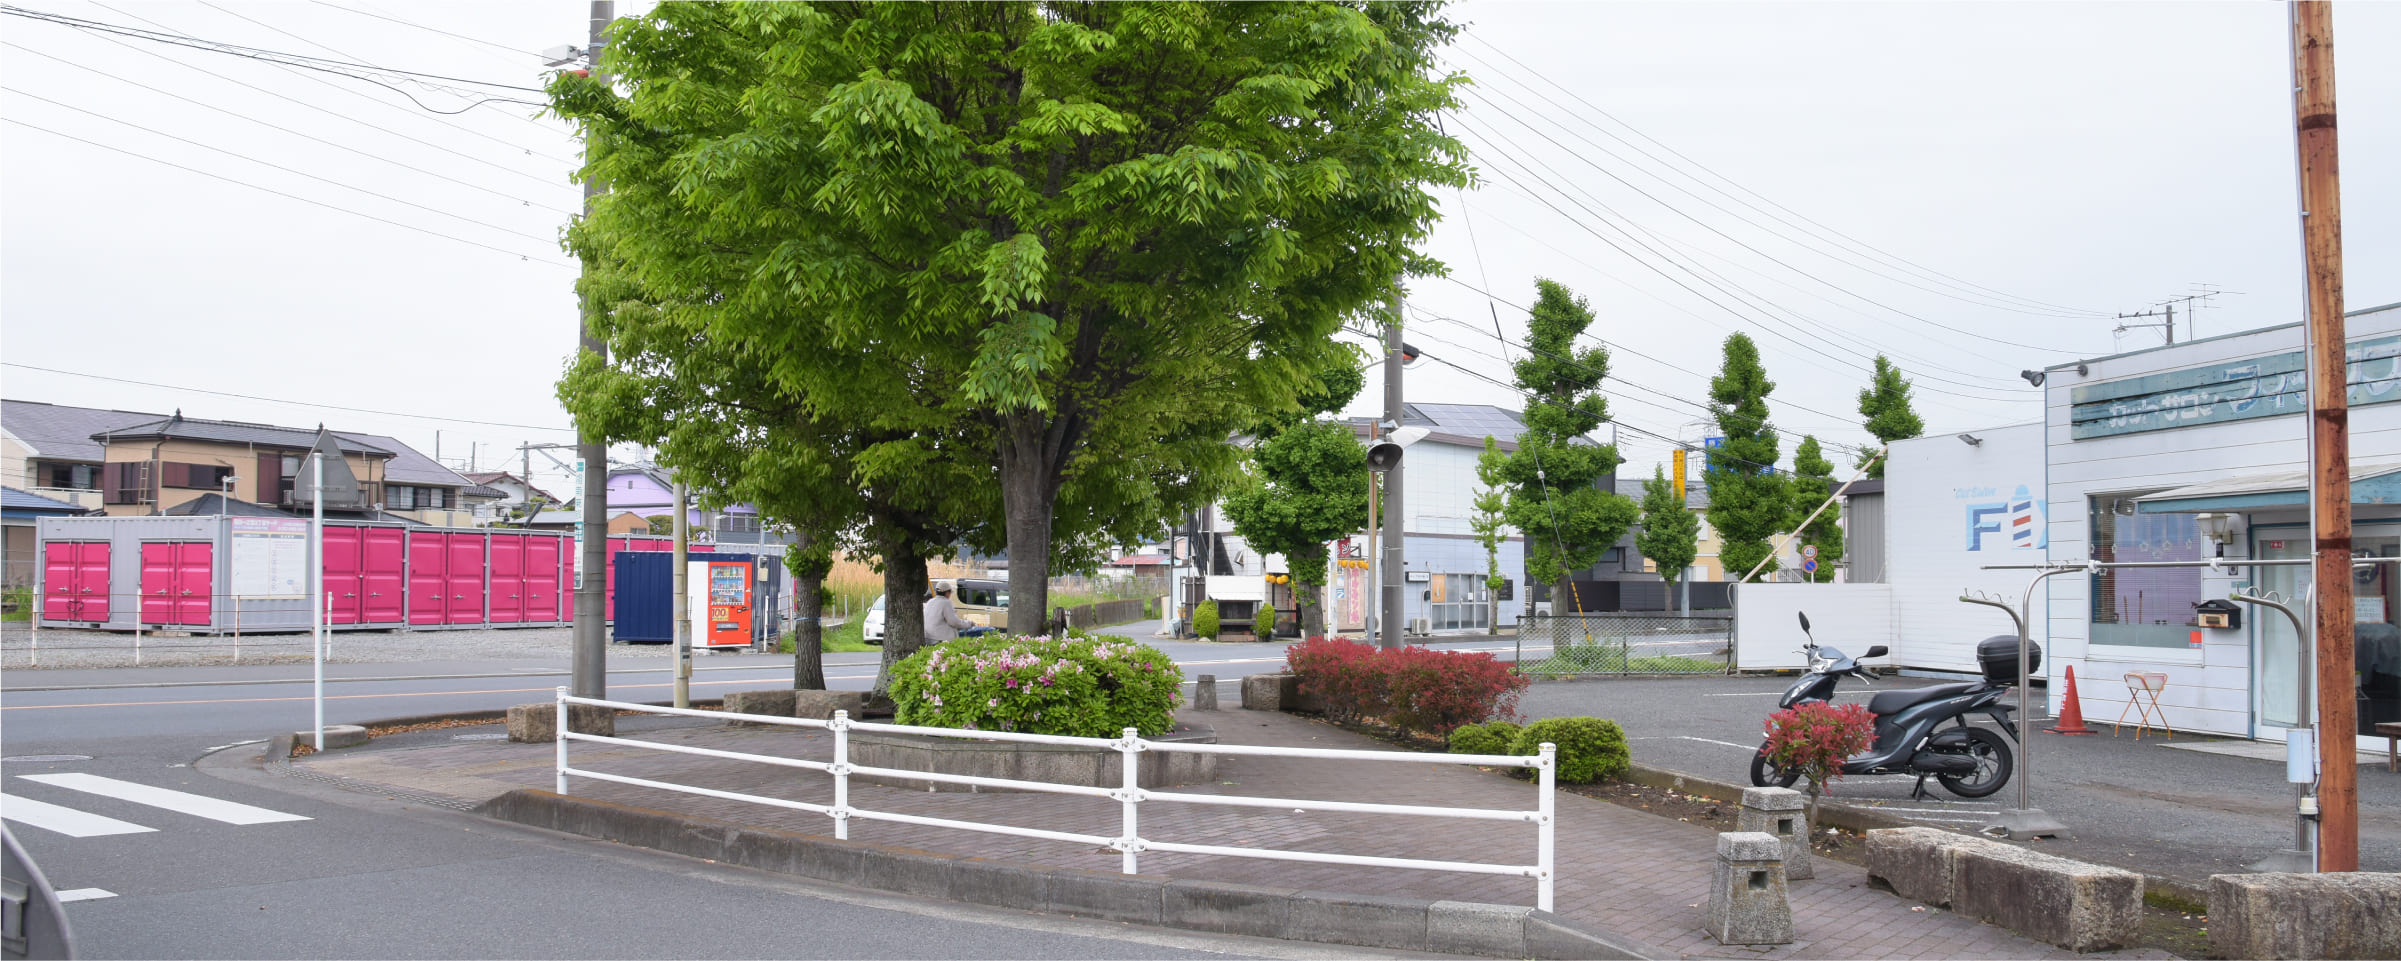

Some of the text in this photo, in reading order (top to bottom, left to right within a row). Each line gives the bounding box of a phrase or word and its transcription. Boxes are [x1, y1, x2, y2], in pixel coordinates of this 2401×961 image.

[2109, 391, 2220, 428] カットサロン
[711, 608, 726, 618] 100
